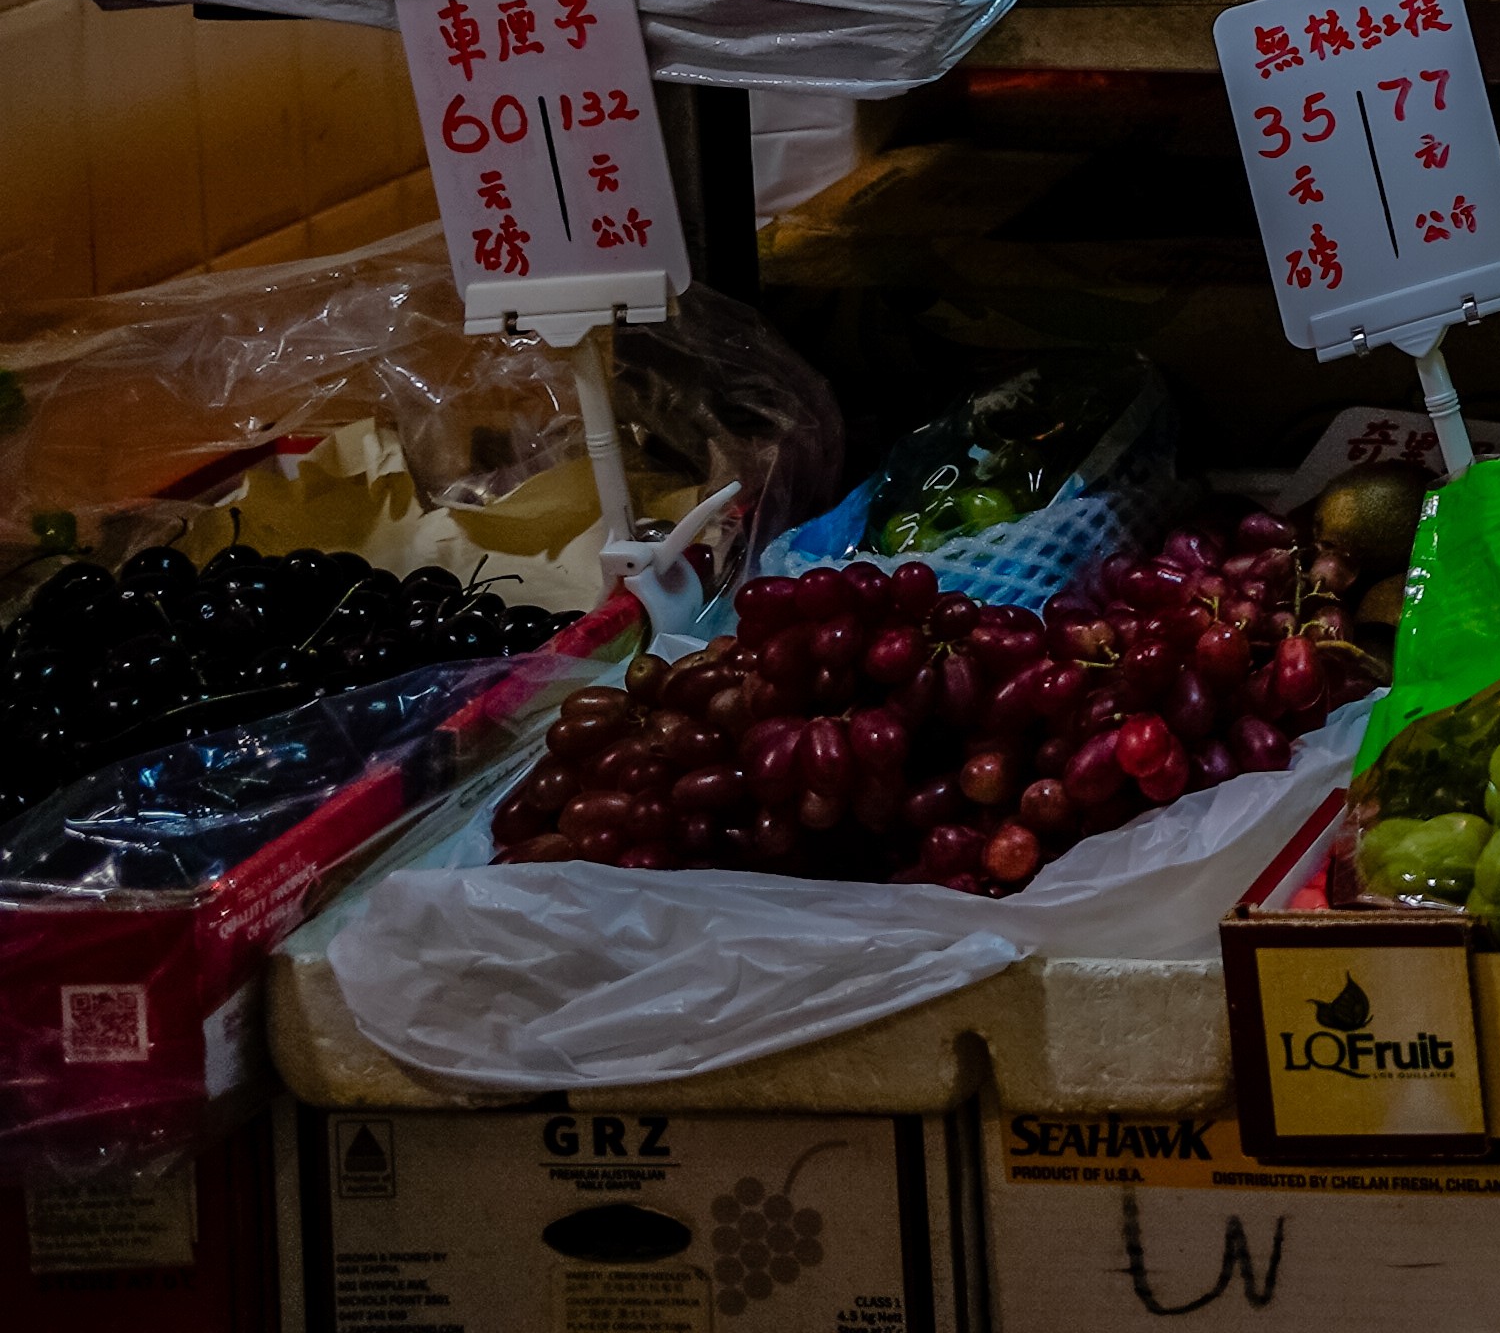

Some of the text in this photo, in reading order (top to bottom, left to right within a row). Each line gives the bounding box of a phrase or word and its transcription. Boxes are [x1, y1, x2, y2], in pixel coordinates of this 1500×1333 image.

[441, 89, 639, 154] 60 132
[1253, 69, 1450, 159] 35 77
[1280, 1030, 1456, 1081] LQFruit
